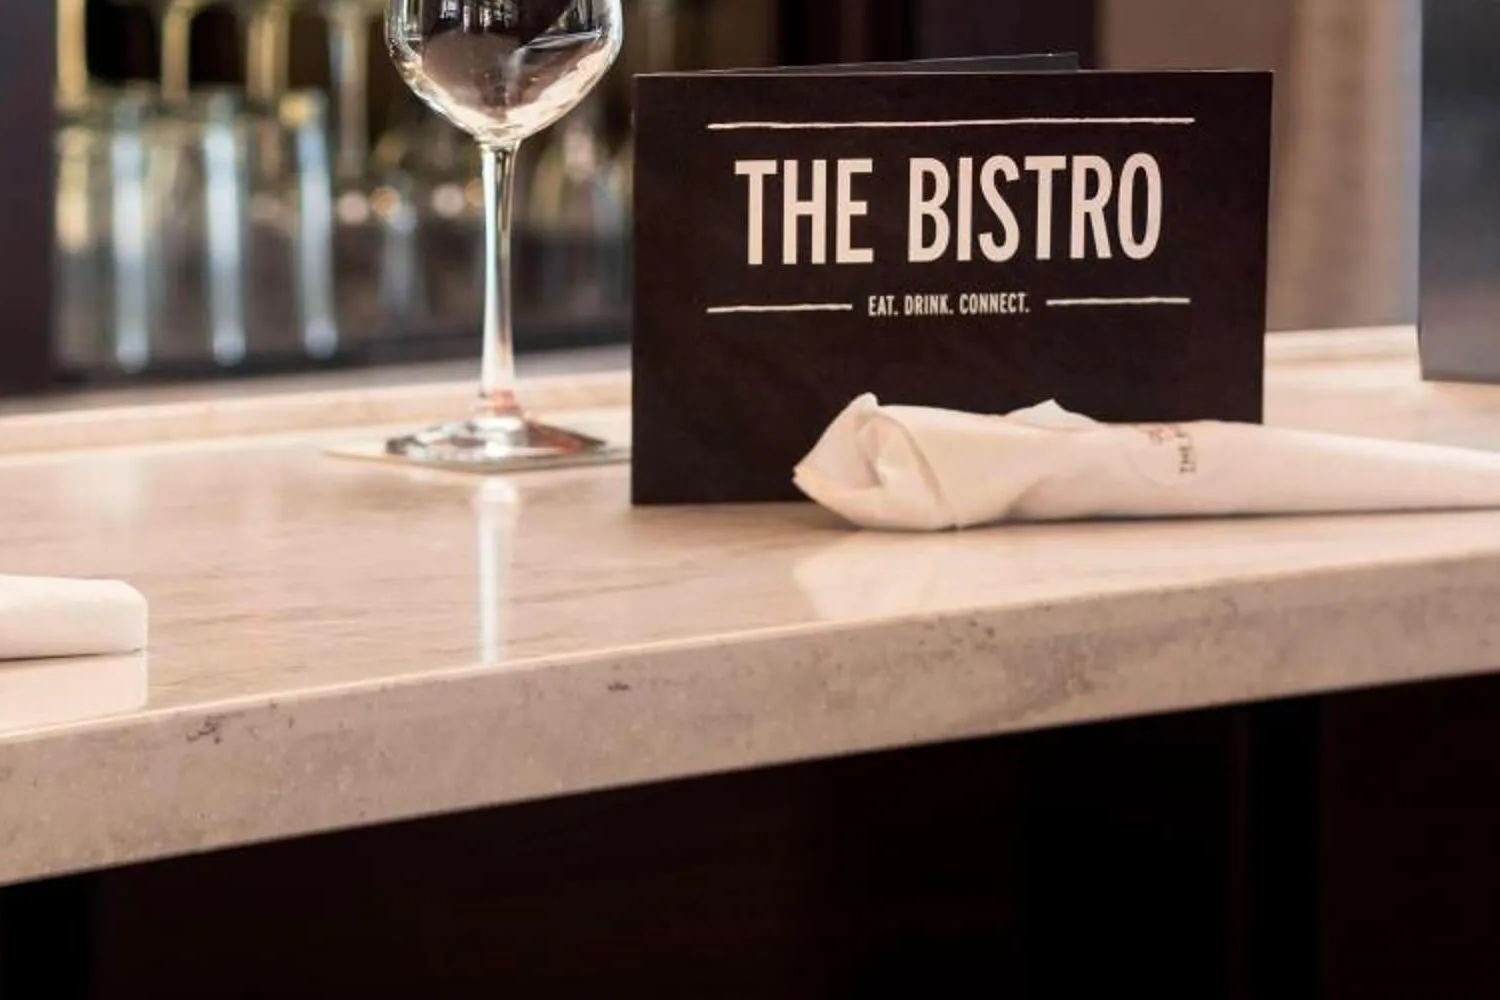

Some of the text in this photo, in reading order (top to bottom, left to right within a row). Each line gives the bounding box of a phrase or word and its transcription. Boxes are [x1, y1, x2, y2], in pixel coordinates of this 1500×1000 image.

[735, 152, 1162, 265] THE BISTRO
[867, 291, 1030, 317] EAT. DRINK. CONNECT.
